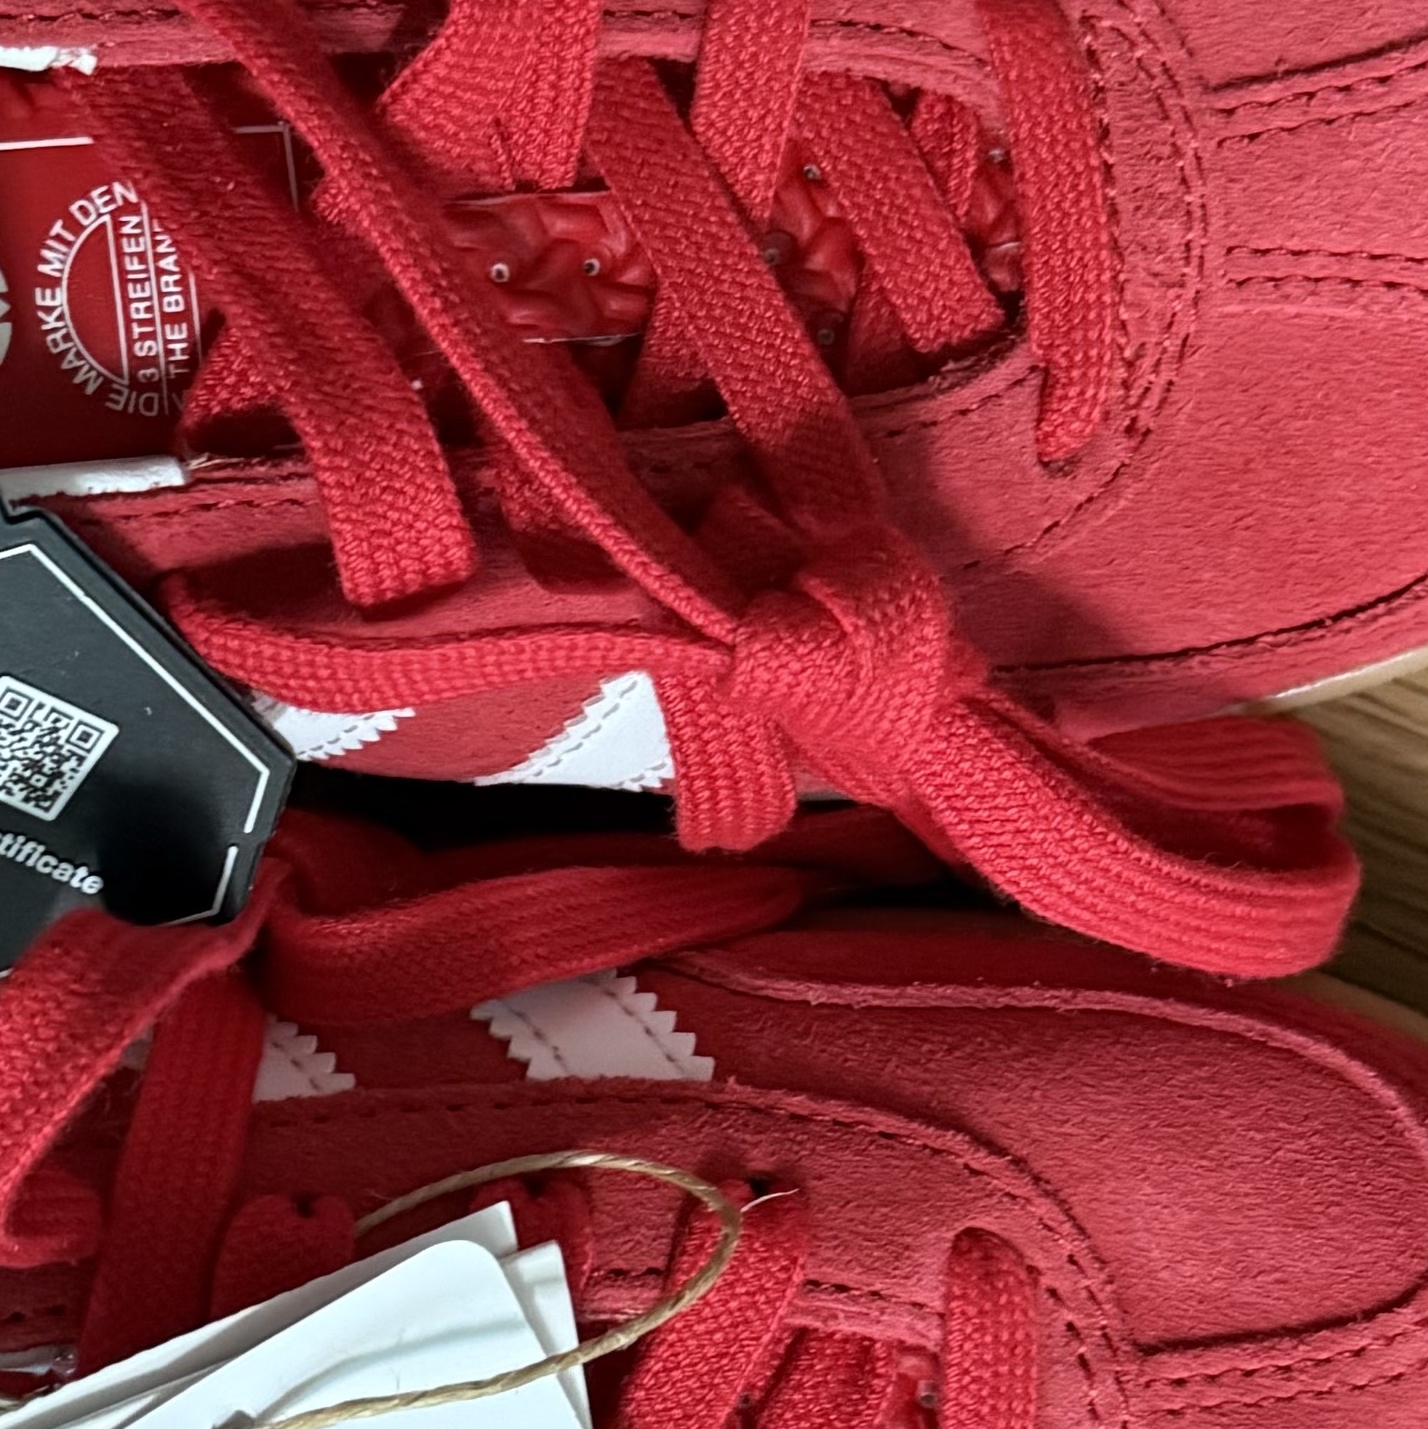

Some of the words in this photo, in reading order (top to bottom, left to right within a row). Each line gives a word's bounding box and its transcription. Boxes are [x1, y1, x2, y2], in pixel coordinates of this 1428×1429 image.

[69, 180, 140, 227] DEN
[37, 219, 76, 278] MIT
[119, 215, 159, 357] STREIFEN
[35, 286, 104, 395] MARKE
[165, 322, 190, 379] THE
[105, 382, 159, 416] DIE
[137, 368, 159, 383] 3
